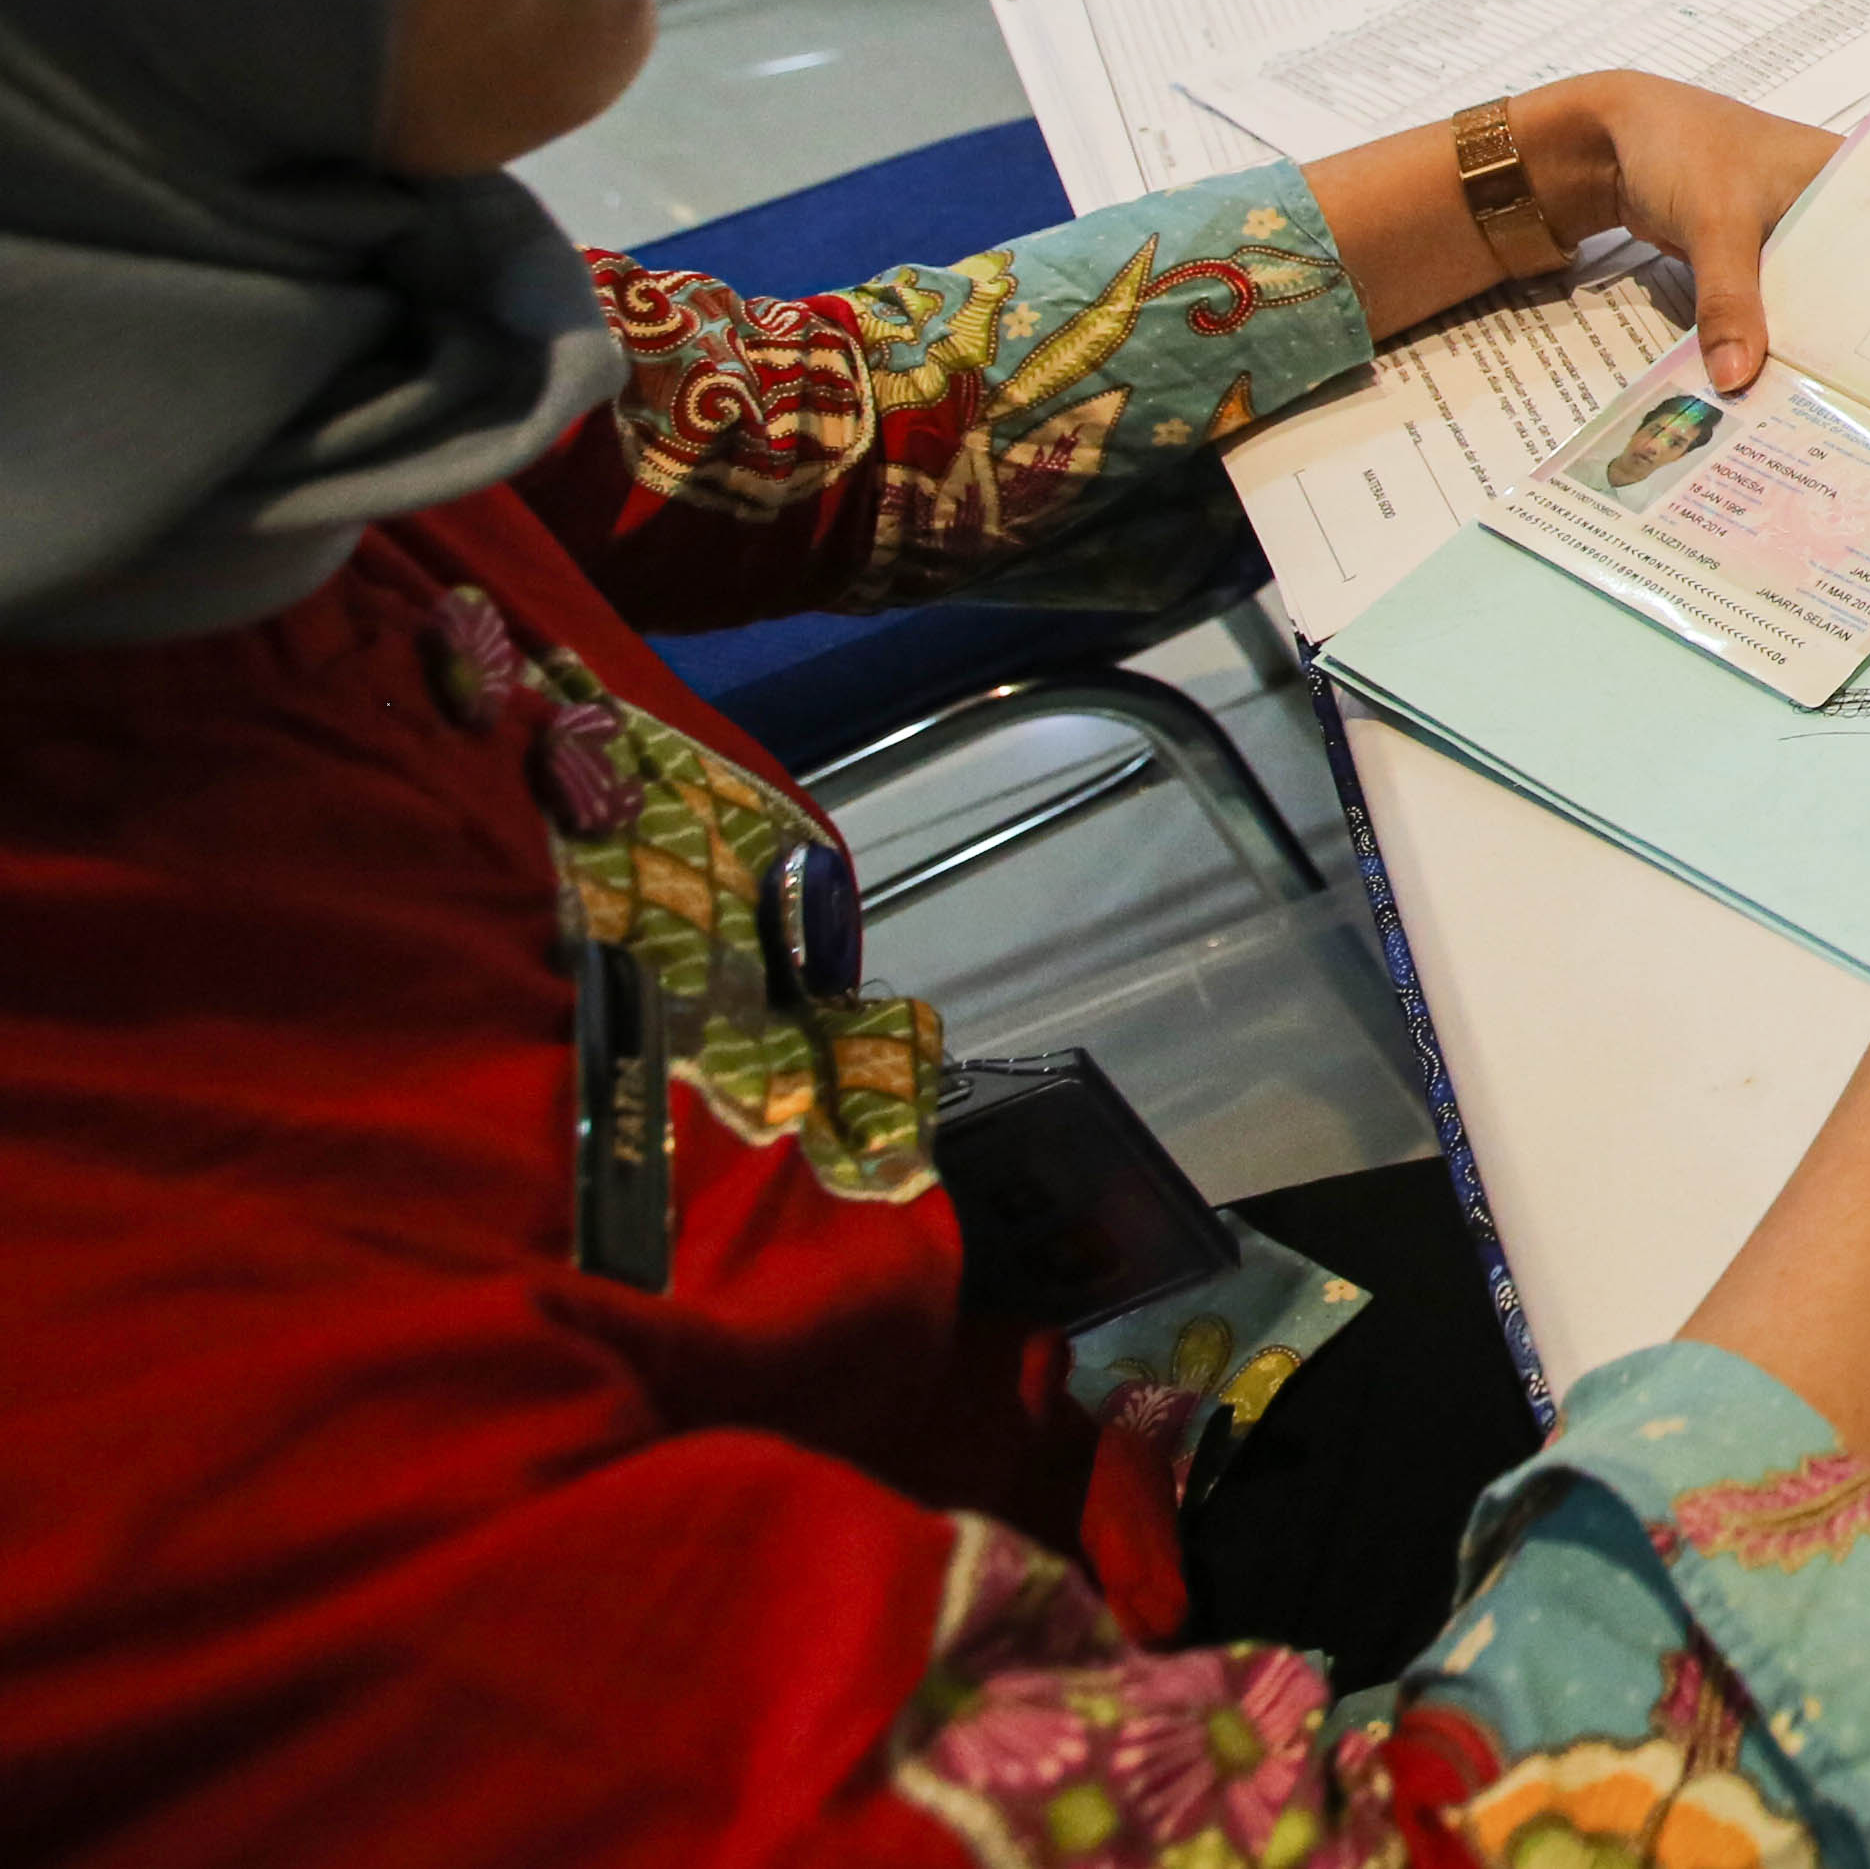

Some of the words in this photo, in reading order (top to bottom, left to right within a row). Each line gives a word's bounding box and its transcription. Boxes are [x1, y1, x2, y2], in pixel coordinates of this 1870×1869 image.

[1756, 421, 1767, 429] P
[1807, 447, 1827, 460] IDN
[1712, 463, 1764, 494] INDONESIA
[1733, 442, 1767, 462] MONTI
[1766, 459, 1837, 499] KRISNANDITYA
[1363, 468, 1385, 501] MATERAI
[1377, 499, 1396, 519] 6000
[1689, 482, 1703, 493] 18
[1700, 490, 1723, 504] JAN
[1723, 499, 1747, 515] 1996
[1668, 501, 1681, 512] 11
[1680, 508, 1705, 524] MAR
[1701, 520, 1728, 537] 2014
[1815, 579, 1829, 590] 11
[1827, 585, 1853, 603] MAR
[1755, 588, 1804, 616] JAKARTA
[1802, 611, 1853, 642] SELATAN
